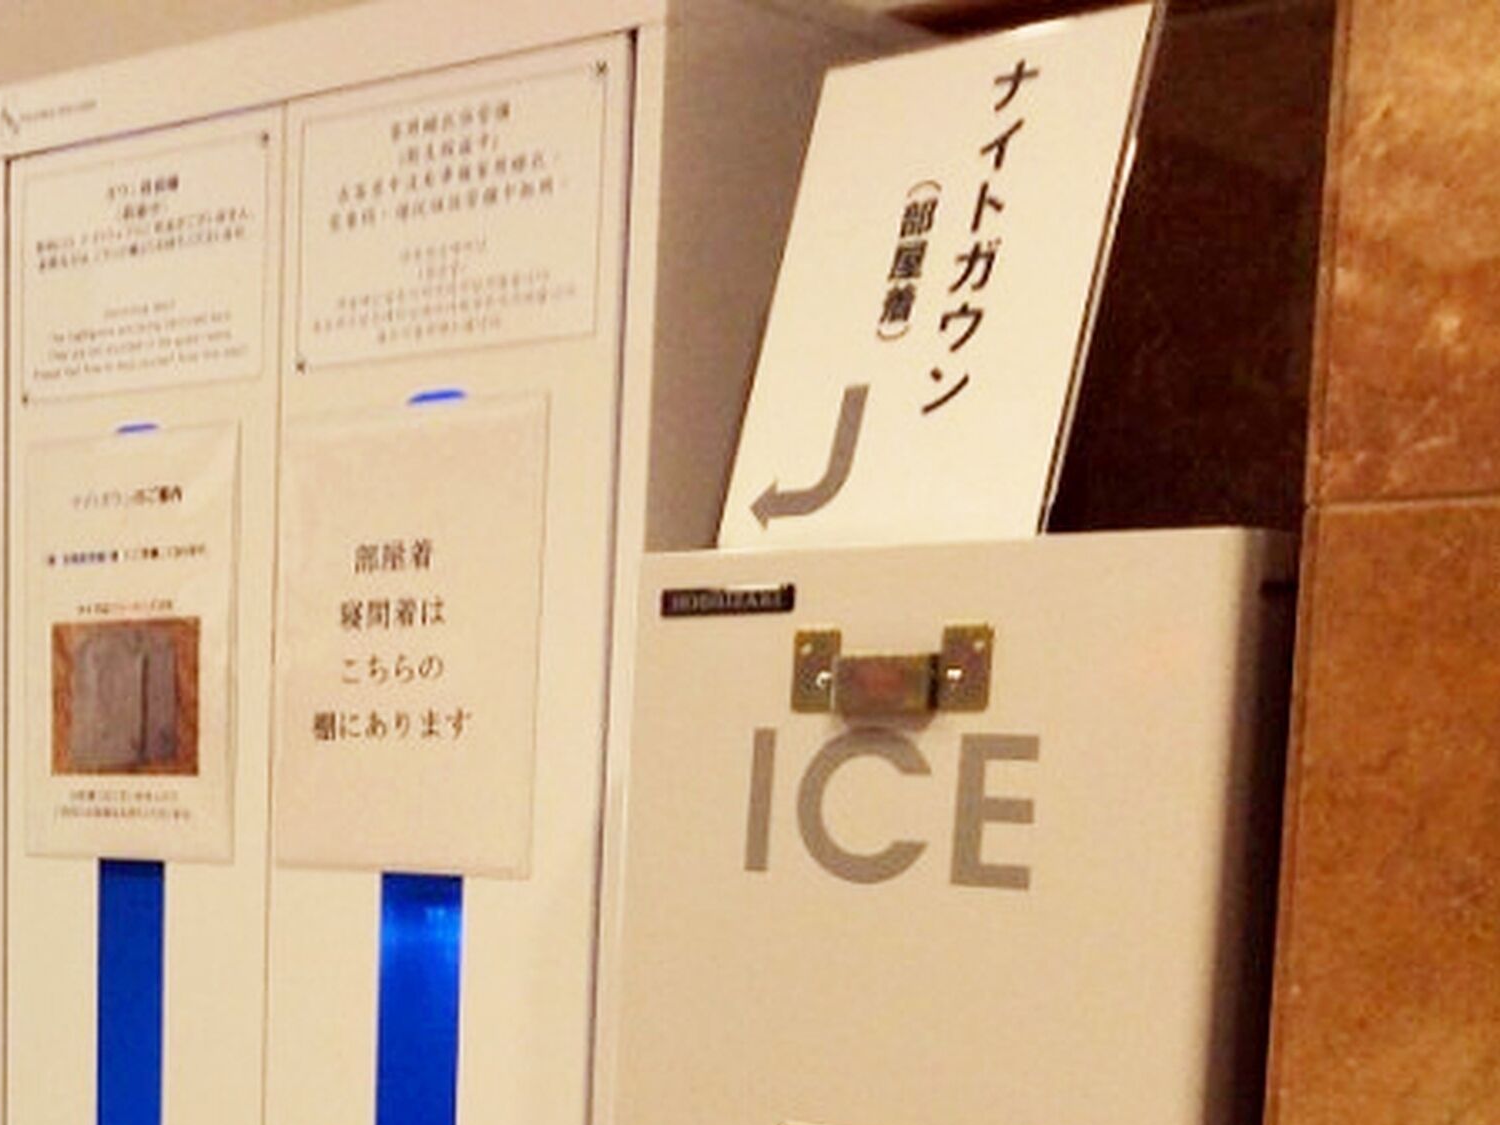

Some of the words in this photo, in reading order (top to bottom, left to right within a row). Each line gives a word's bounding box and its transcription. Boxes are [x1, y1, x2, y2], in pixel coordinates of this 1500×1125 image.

[922, 59, 1039, 415] ナイトガウン
[353, 538, 432, 574] 部屋着
[341, 653, 444, 685] こちらの
[313, 706, 473, 741] 棚にあります
[744, 726, 1041, 891] ICE
